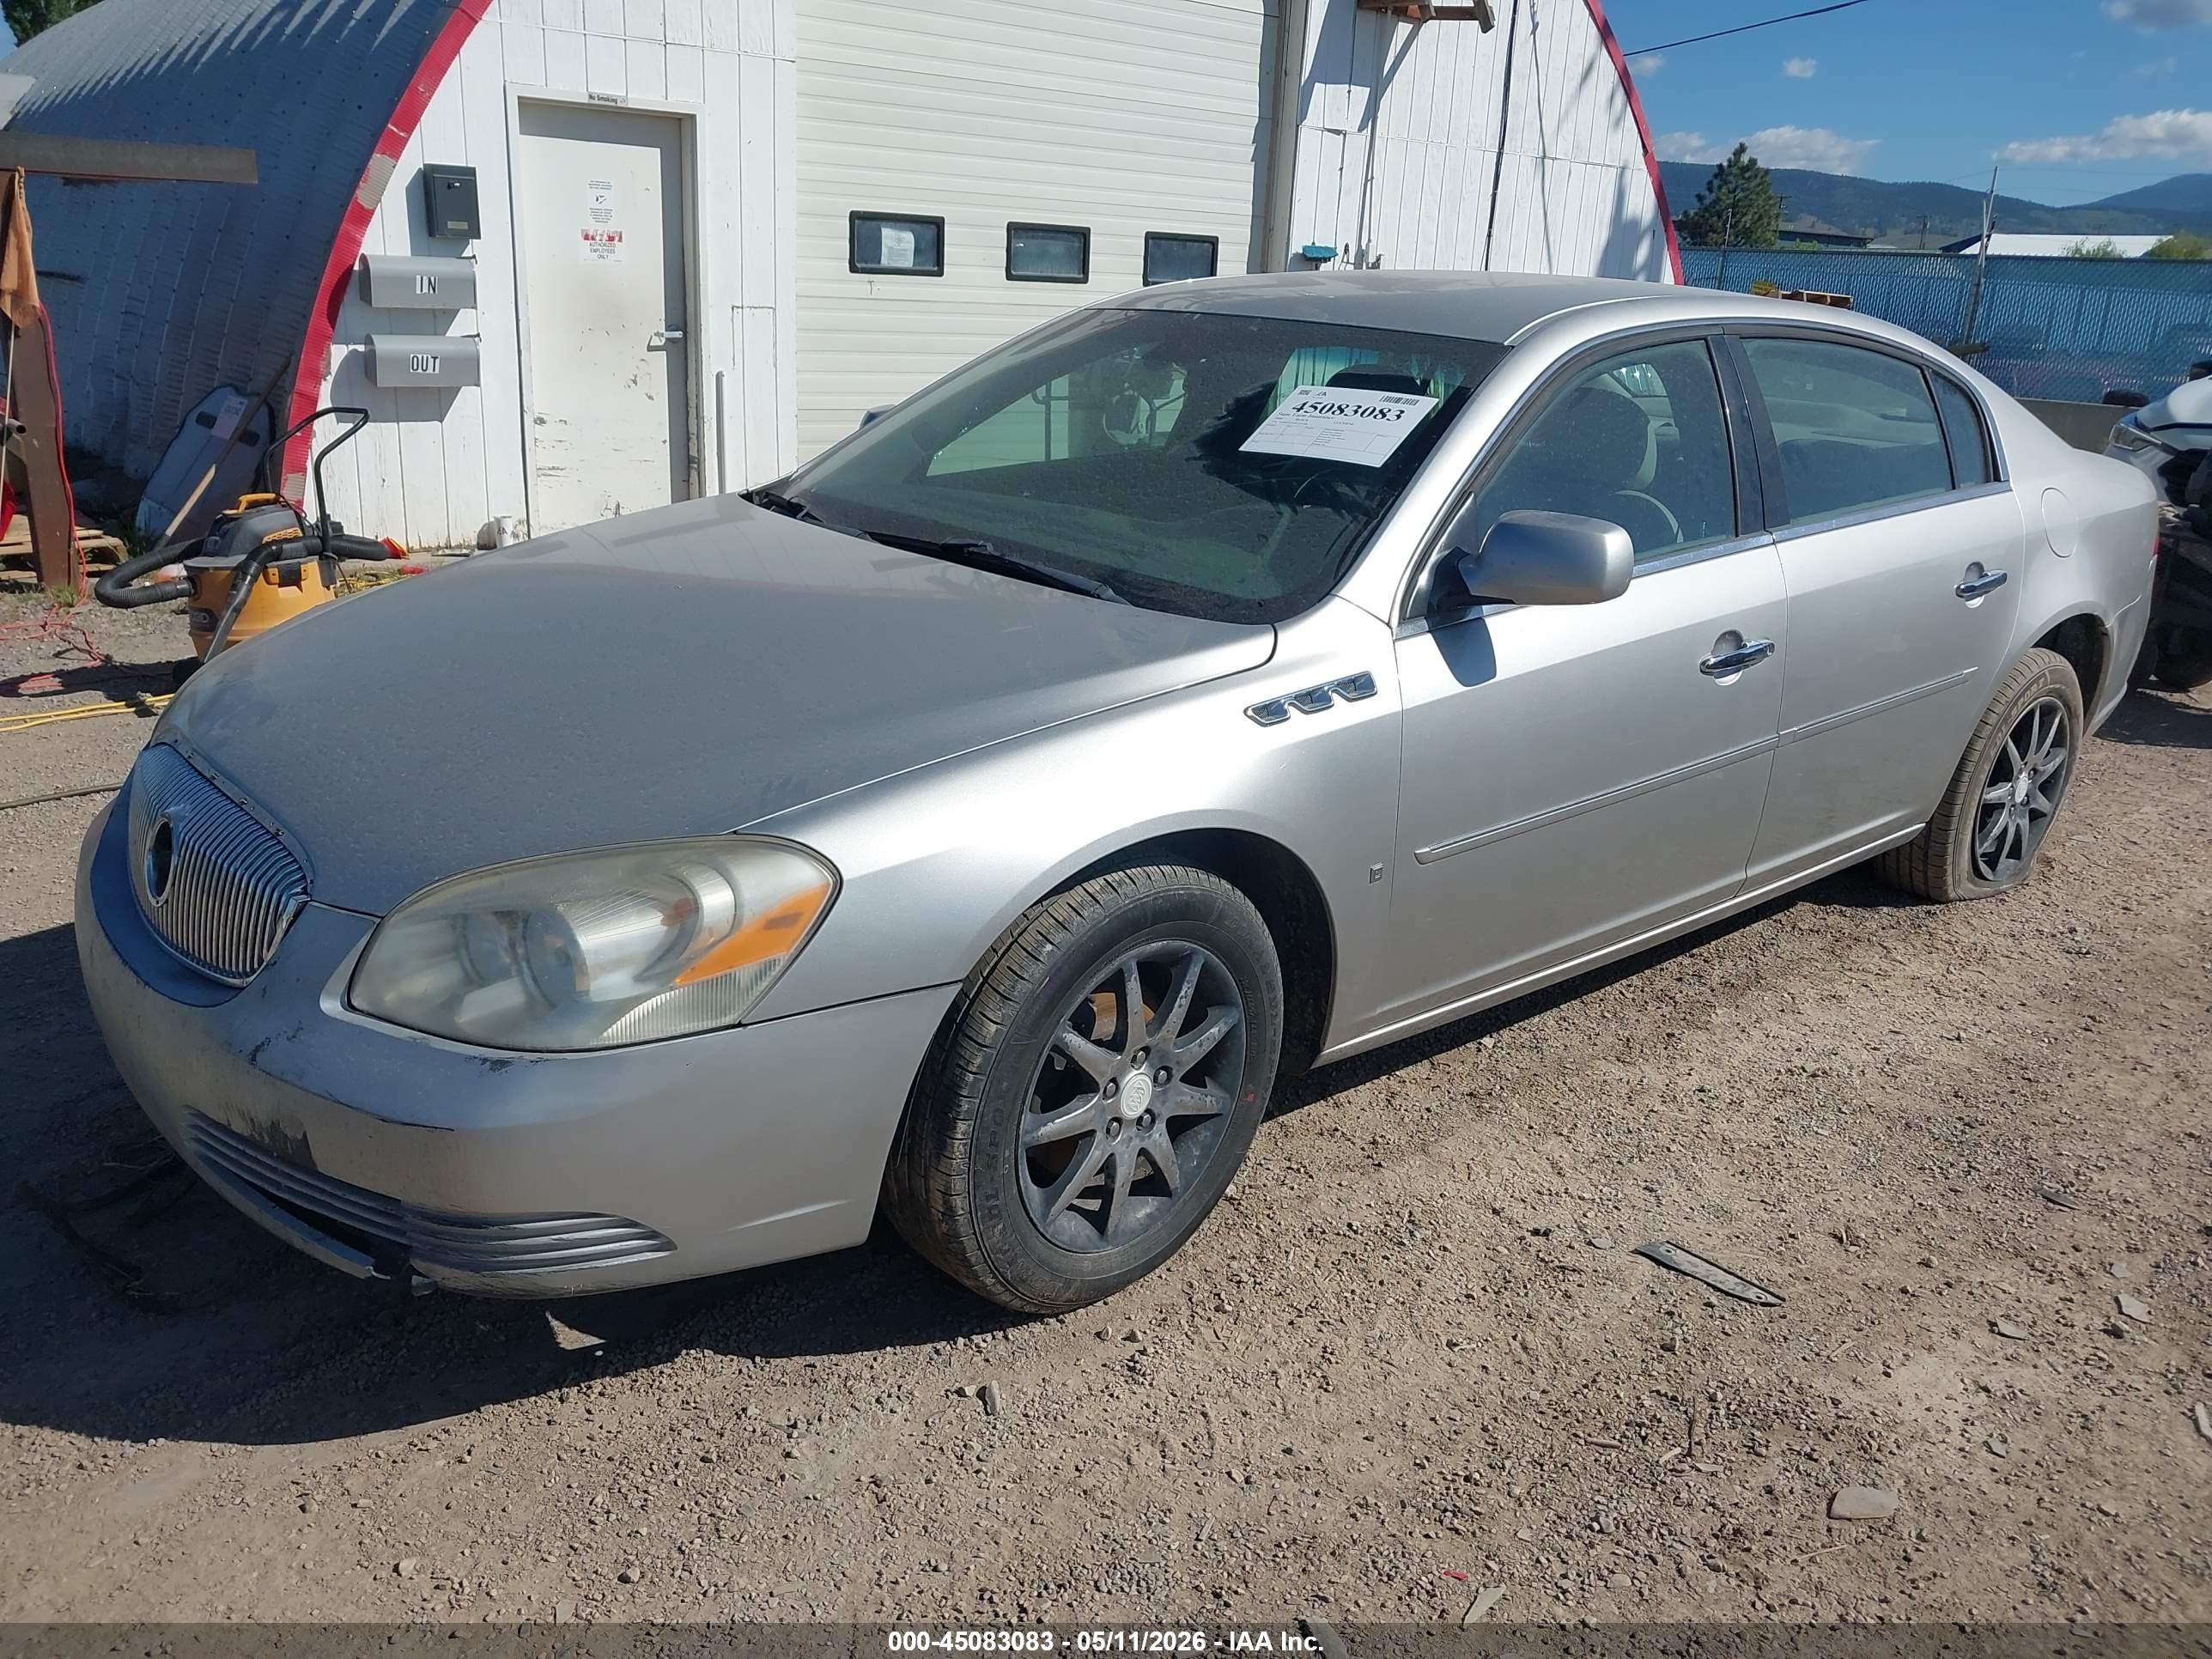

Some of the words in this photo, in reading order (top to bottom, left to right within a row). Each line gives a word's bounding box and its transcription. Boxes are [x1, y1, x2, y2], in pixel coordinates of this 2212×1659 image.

[597, 94, 618, 105] Smoking
[420, 276, 436, 295] IN
[411, 355, 439, 373] OUT
[1291, 400, 1406, 422] 45083083
